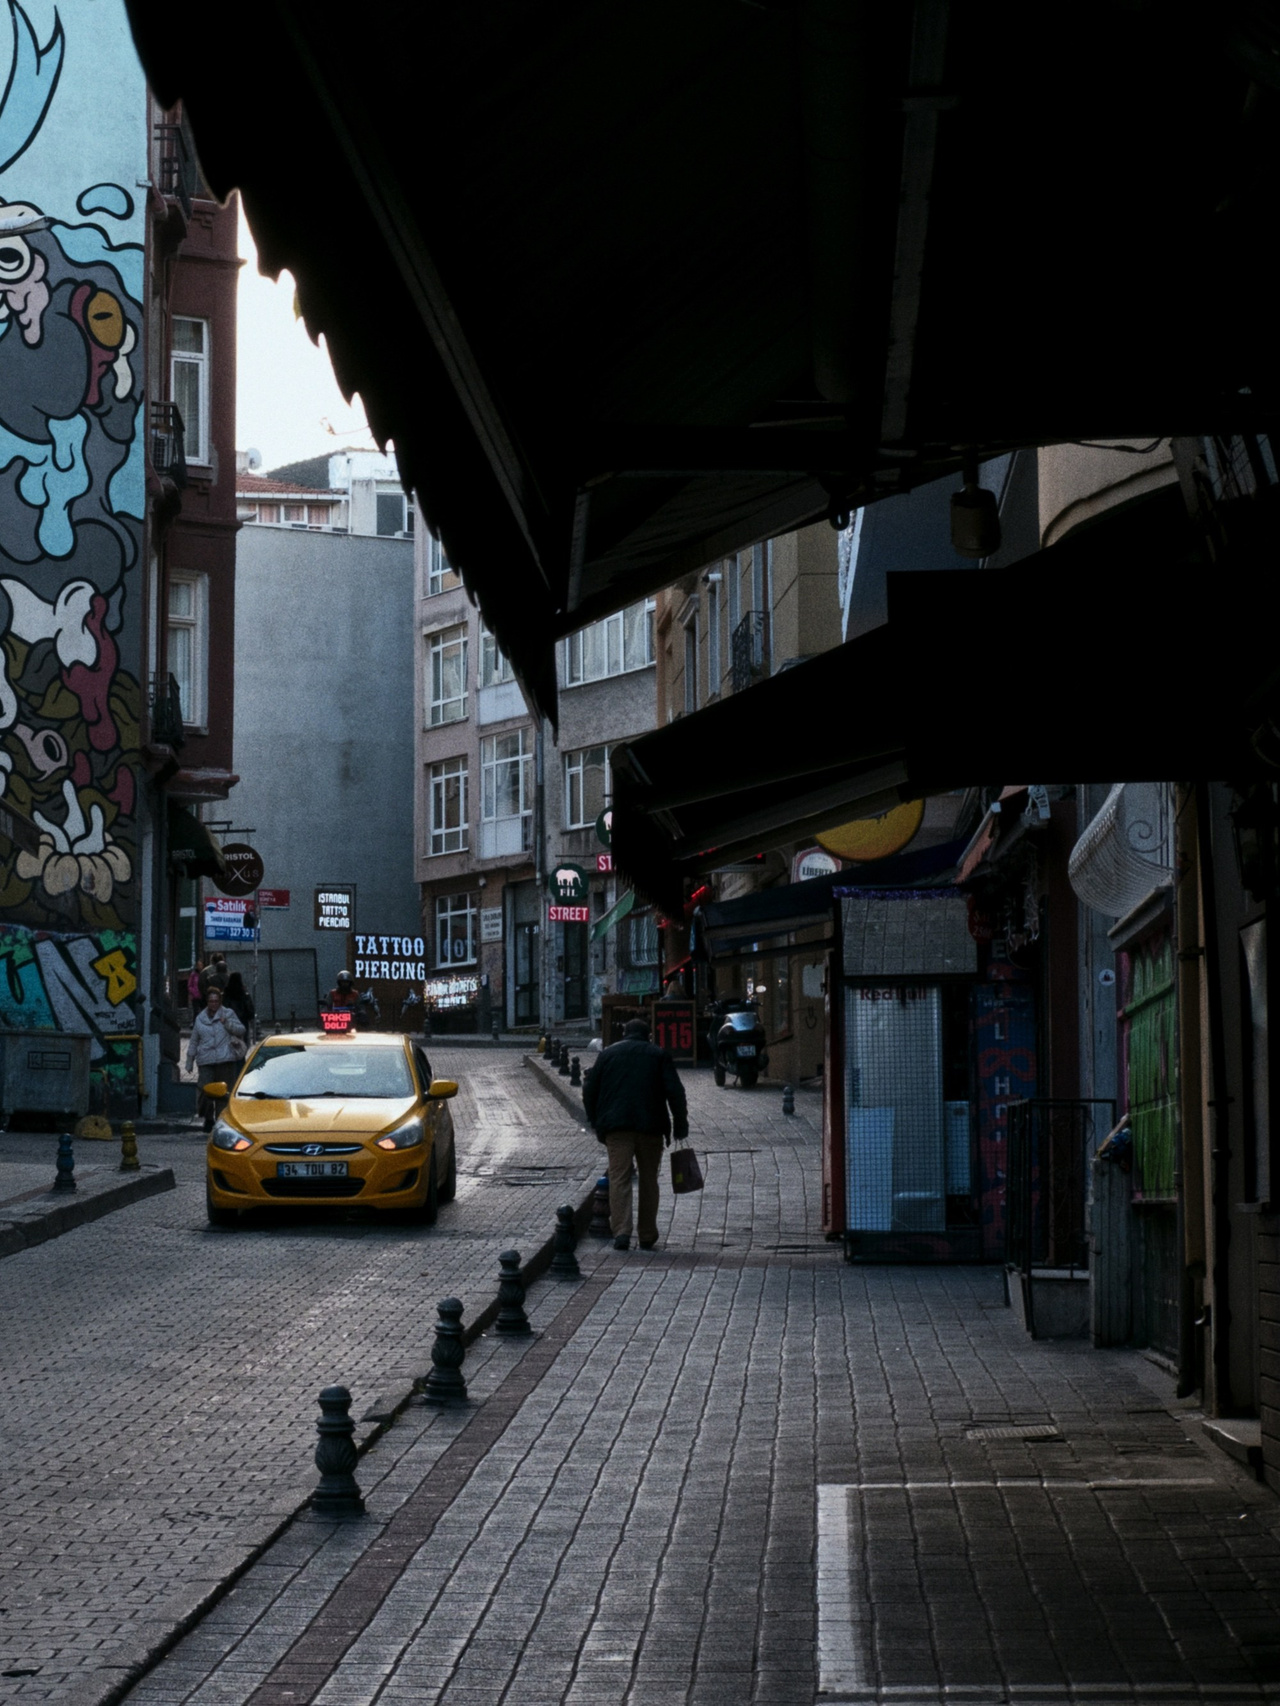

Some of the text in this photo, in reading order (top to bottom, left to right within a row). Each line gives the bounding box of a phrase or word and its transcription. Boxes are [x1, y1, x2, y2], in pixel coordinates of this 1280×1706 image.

[223, 852, 255, 861] RISTOL
[560, 886, 578, 897] FİL
[217, 899, 247, 912] Satılık
[549, 906, 589, 921] STREET
[355, 935, 425, 957] TATTOO
[355, 960, 426, 981] PIERCING
[861, 984, 892, 1000] Red
[324, 1022, 348, 1030] DOLU
[656, 1021, 692, 1049] 115
[285, 1164, 298, 1176] 34
[331, 1163, 345, 1175] 82
